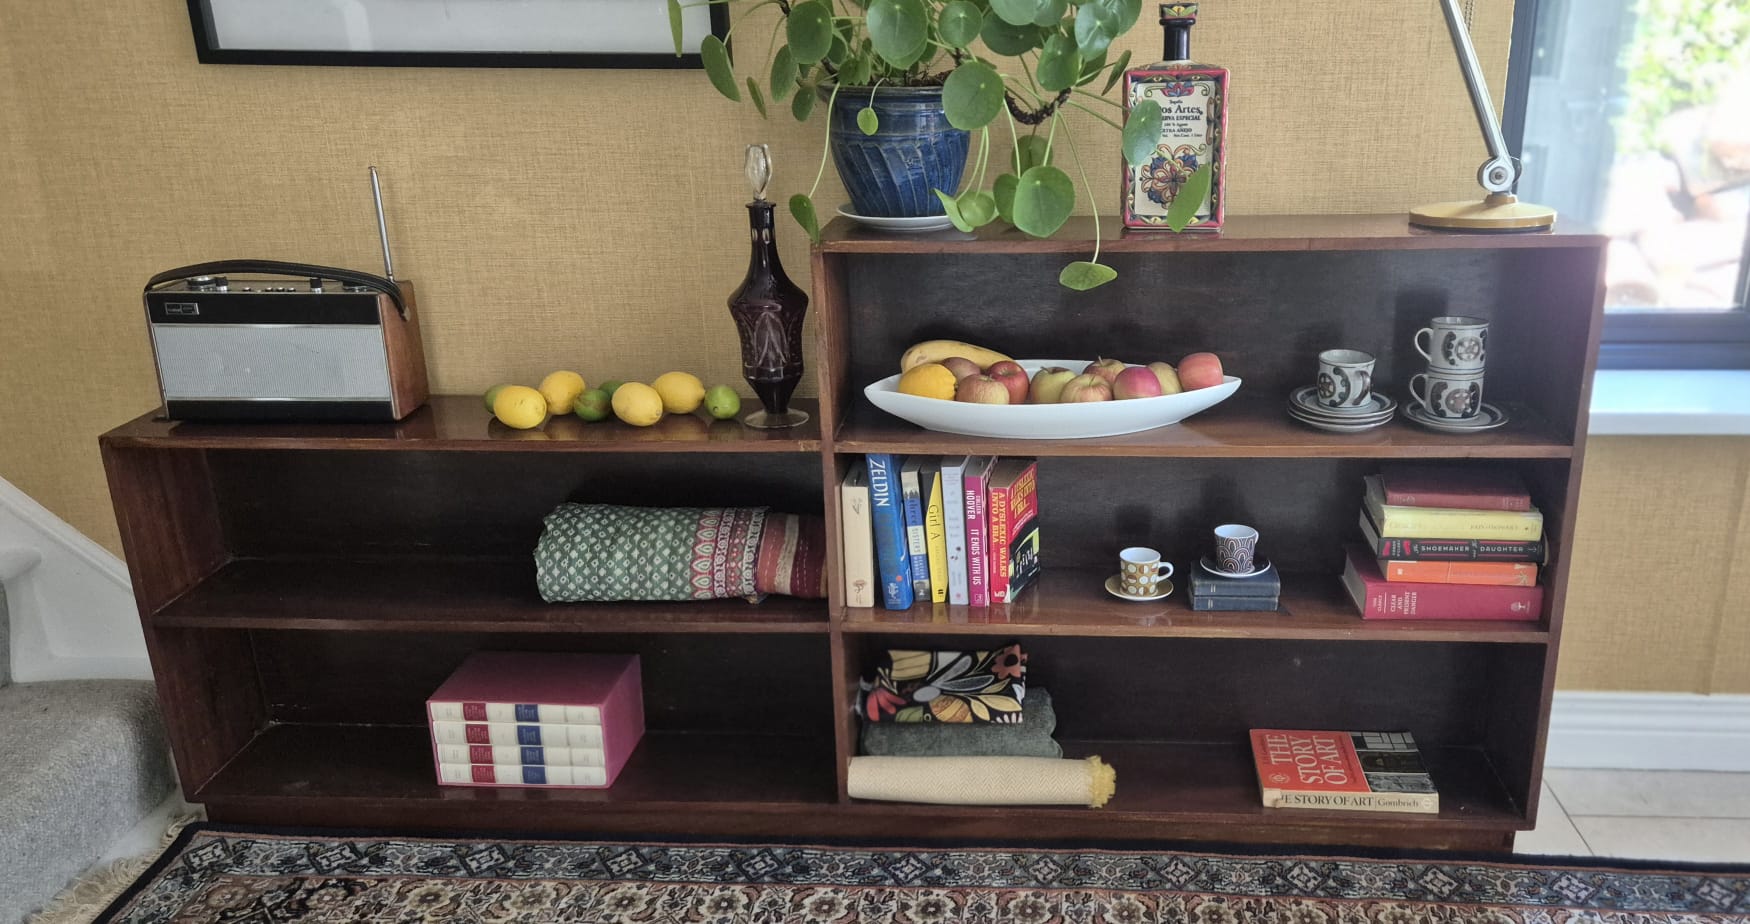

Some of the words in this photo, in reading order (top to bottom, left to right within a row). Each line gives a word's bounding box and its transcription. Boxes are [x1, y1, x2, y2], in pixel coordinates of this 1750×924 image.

[1160, 105, 1172, 113] os
[869, 457, 891, 506] ZELDIN
[966, 490, 976, 520] HOOVER
[991, 492, 999, 514] INTO
[929, 504, 941, 527] Girl
[999, 500, 1007, 545] DYSLEXIC
[930, 532, 941, 540] A
[970, 528, 979, 536] IT
[970, 537, 980, 555] ENDS
[1480, 545, 1524, 553] DAUGHTER
[972, 556, 981, 575] WITH
[972, 575, 982, 585] US
[1266, 734, 1293, 765] THE
[1289, 735, 1324, 784] STORY
[1312, 735, 1342, 765] ART
[1321, 764, 1348, 785] OF
[1294, 794, 1334, 805] STORY
[1333, 795, 1348, 805] OF
[1349, 796, 1375, 807] ART
[1377, 798, 1419, 808] Gombrich
